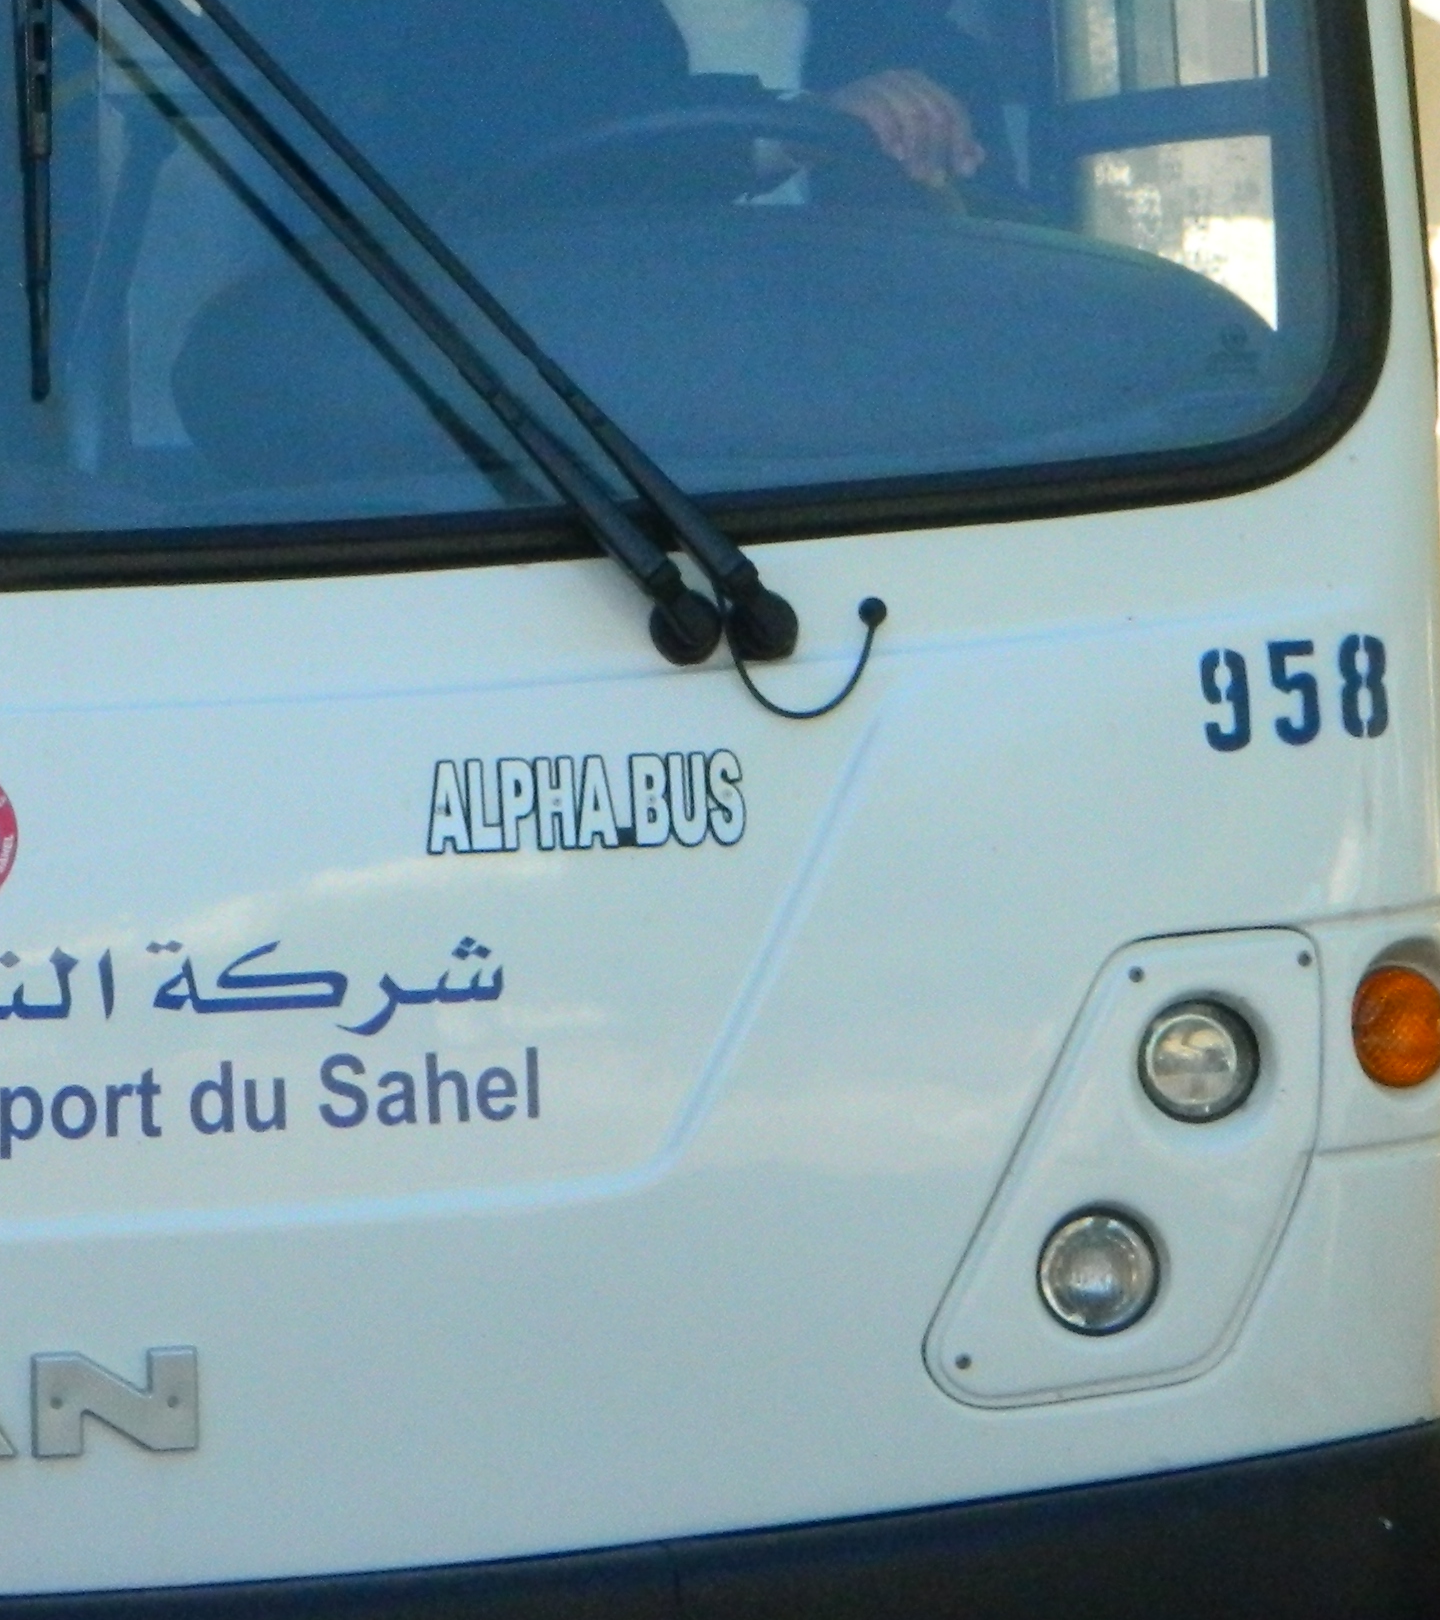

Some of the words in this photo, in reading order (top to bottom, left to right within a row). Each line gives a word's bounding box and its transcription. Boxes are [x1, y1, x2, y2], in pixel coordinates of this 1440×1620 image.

[1200, 633, 1389, 752] 958
[146, 935, 505, 1037] شركة
[189, 1060, 287, 1135] du
[318, 1046, 541, 1129] Sahel
